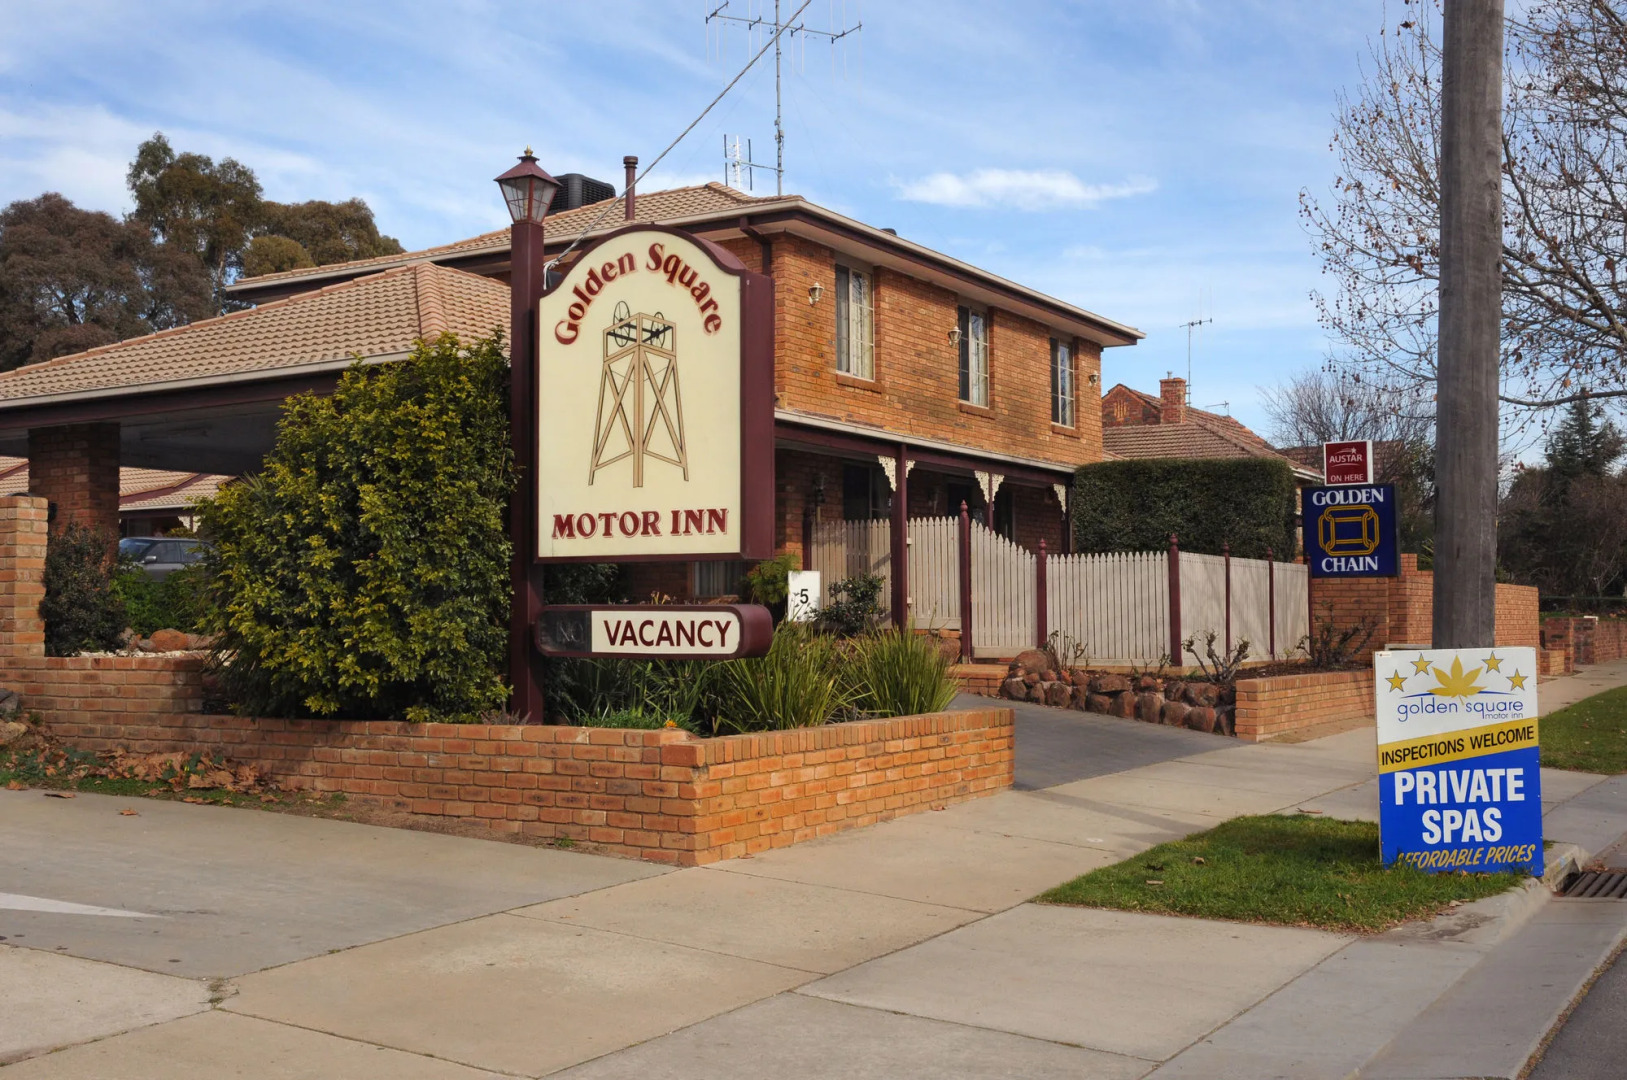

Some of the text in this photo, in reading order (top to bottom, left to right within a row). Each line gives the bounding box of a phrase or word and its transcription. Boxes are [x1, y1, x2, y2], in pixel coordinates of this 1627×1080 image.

[554, 242, 722, 345] Golden Square
[1329, 453, 1363, 463] AUSTAR
[1330, 473, 1364, 482] ON HERE
[1312, 488, 1384, 506] GOLDEN
[552, 508, 729, 539] MOTOR INN
[1321, 556, 1379, 572] CHAIN
[800, 588, 809, 604] 5
[603, 619, 732, 647] VACANCY
[1397, 697, 1524, 722] golden square
[1511, 711, 1524, 719] inn
[1381, 725, 1535, 765] INSPECTIONS WELCOME
[1394, 768, 1525, 805] PRIVATE
[1422, 807, 1502, 844] SPAS
[1484, 844, 1536, 864] PRICES
